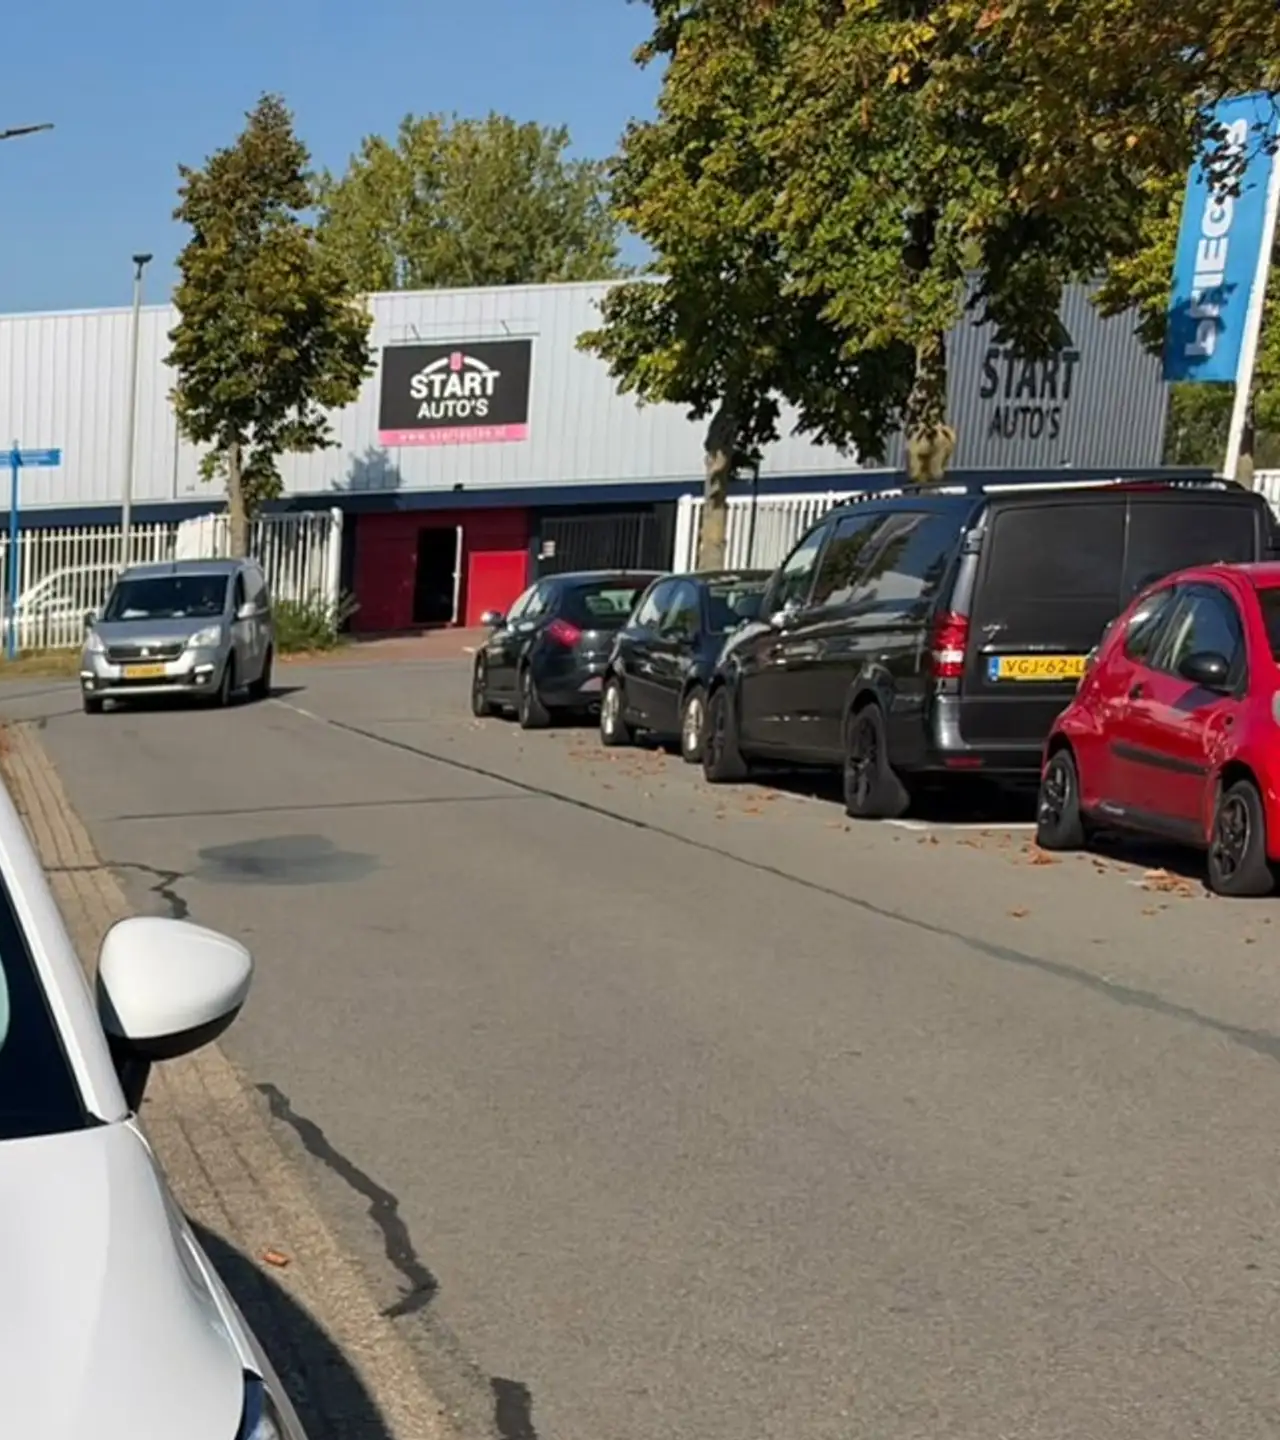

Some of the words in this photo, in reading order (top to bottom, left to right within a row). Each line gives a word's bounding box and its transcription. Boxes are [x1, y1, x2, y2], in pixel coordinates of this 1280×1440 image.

[410, 371, 501, 399] START
[979, 348, 1081, 400] START
[417, 399, 489, 420] AUTO'S
[988, 405, 1062, 440] AUTO'S
